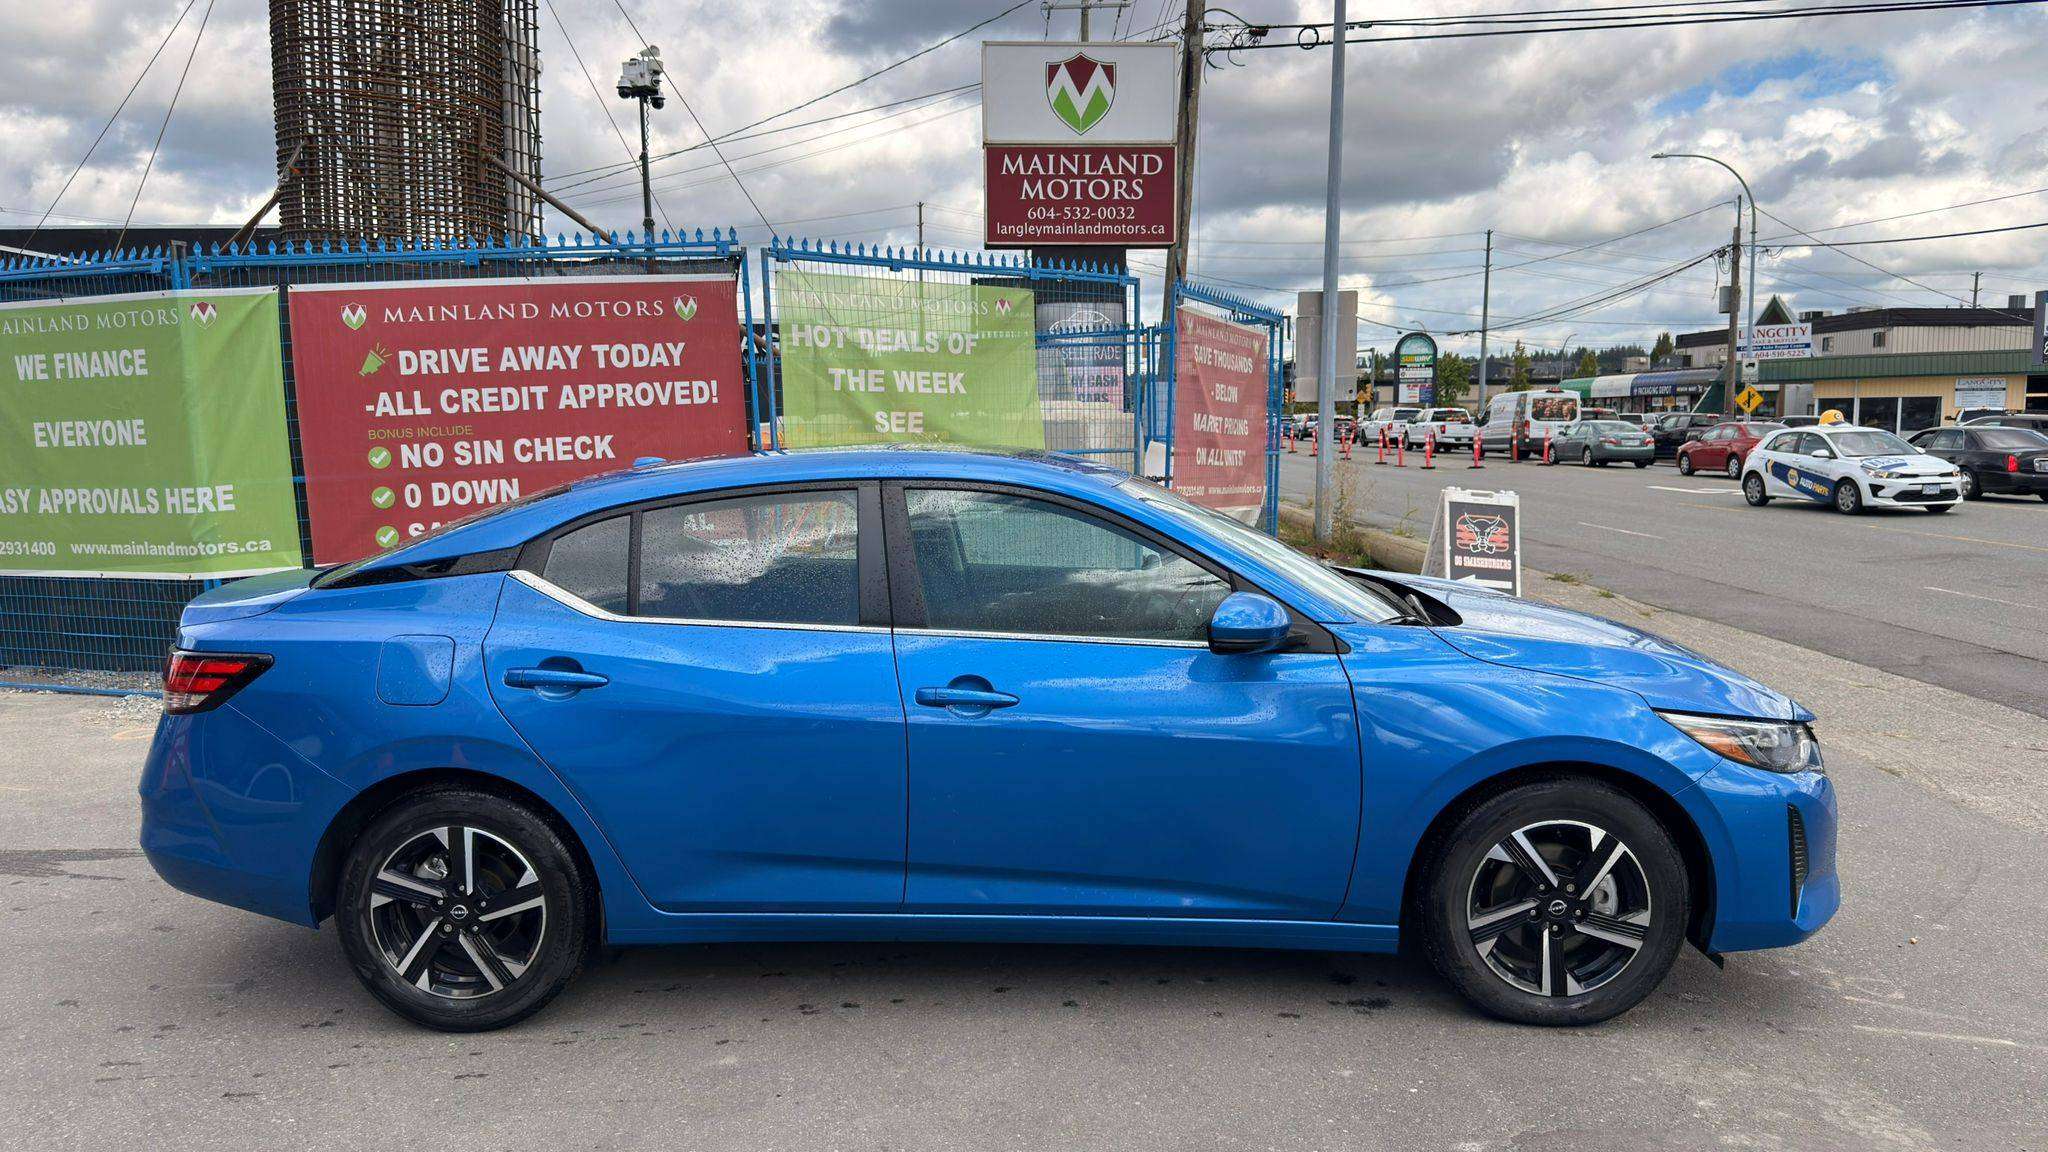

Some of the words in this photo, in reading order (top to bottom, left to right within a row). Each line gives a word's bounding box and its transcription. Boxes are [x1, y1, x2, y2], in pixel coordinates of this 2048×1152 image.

[1001, 153, 1163, 175] MAINLAND
[1020, 178, 1144, 200] MOTORS
[1027, 206, 1135, 220] 604-532-0032
[997, 222, 1165, 237] langleymainlandmotors.ca
[384, 302, 540, 323] MAINLAND
[550, 299, 664, 319] MOTORS
[911, 299, 989, 316] MOTORS
[2, 314, 89, 335] AINLAND
[97, 308, 179, 329] MOTORS
[792, 323, 852, 349] HOT
[859, 327, 940, 353] DEALS
[947, 332, 978, 355] OF
[15, 353, 49, 381] WE
[53, 348, 148, 379] FINANCE
[398, 347, 490, 376] DRIVE
[500, 344, 583, 371] AWAY
[591, 342, 685, 369] TODAY
[1088, 346, 1121, 361] TRADE
[1194, 344, 1213, 366] SAVE
[1214, 349, 1253, 374] THOUSANDS
[828, 367, 885, 393] THE
[892, 369, 968, 394] WEEK
[1215, 382, 1238, 403] BELOW
[365, 390, 431, 417] -ALL
[440, 385, 549, 414] CREDIT
[558, 379, 719, 410] APPROVED!
[33, 418, 147, 448] EVERYONE
[368, 427, 414, 440] BONUS
[417, 425, 473, 438] INCLUDE
[875, 411, 923, 433] SEE
[400, 442, 445, 469] NO
[454, 439, 504, 466] SIN
[513, 434, 616, 462] CHECK
[1196, 447, 1207, 466] ON
[1207, 447, 1224, 467] ALL
[38, 487, 160, 514] APPROVALS
[165, 484, 236, 514] HERE
[404, 482, 422, 509] 0
[431, 477, 520, 507] DOWN
[70, 540, 272, 556] www.mainlandmotors.ca
